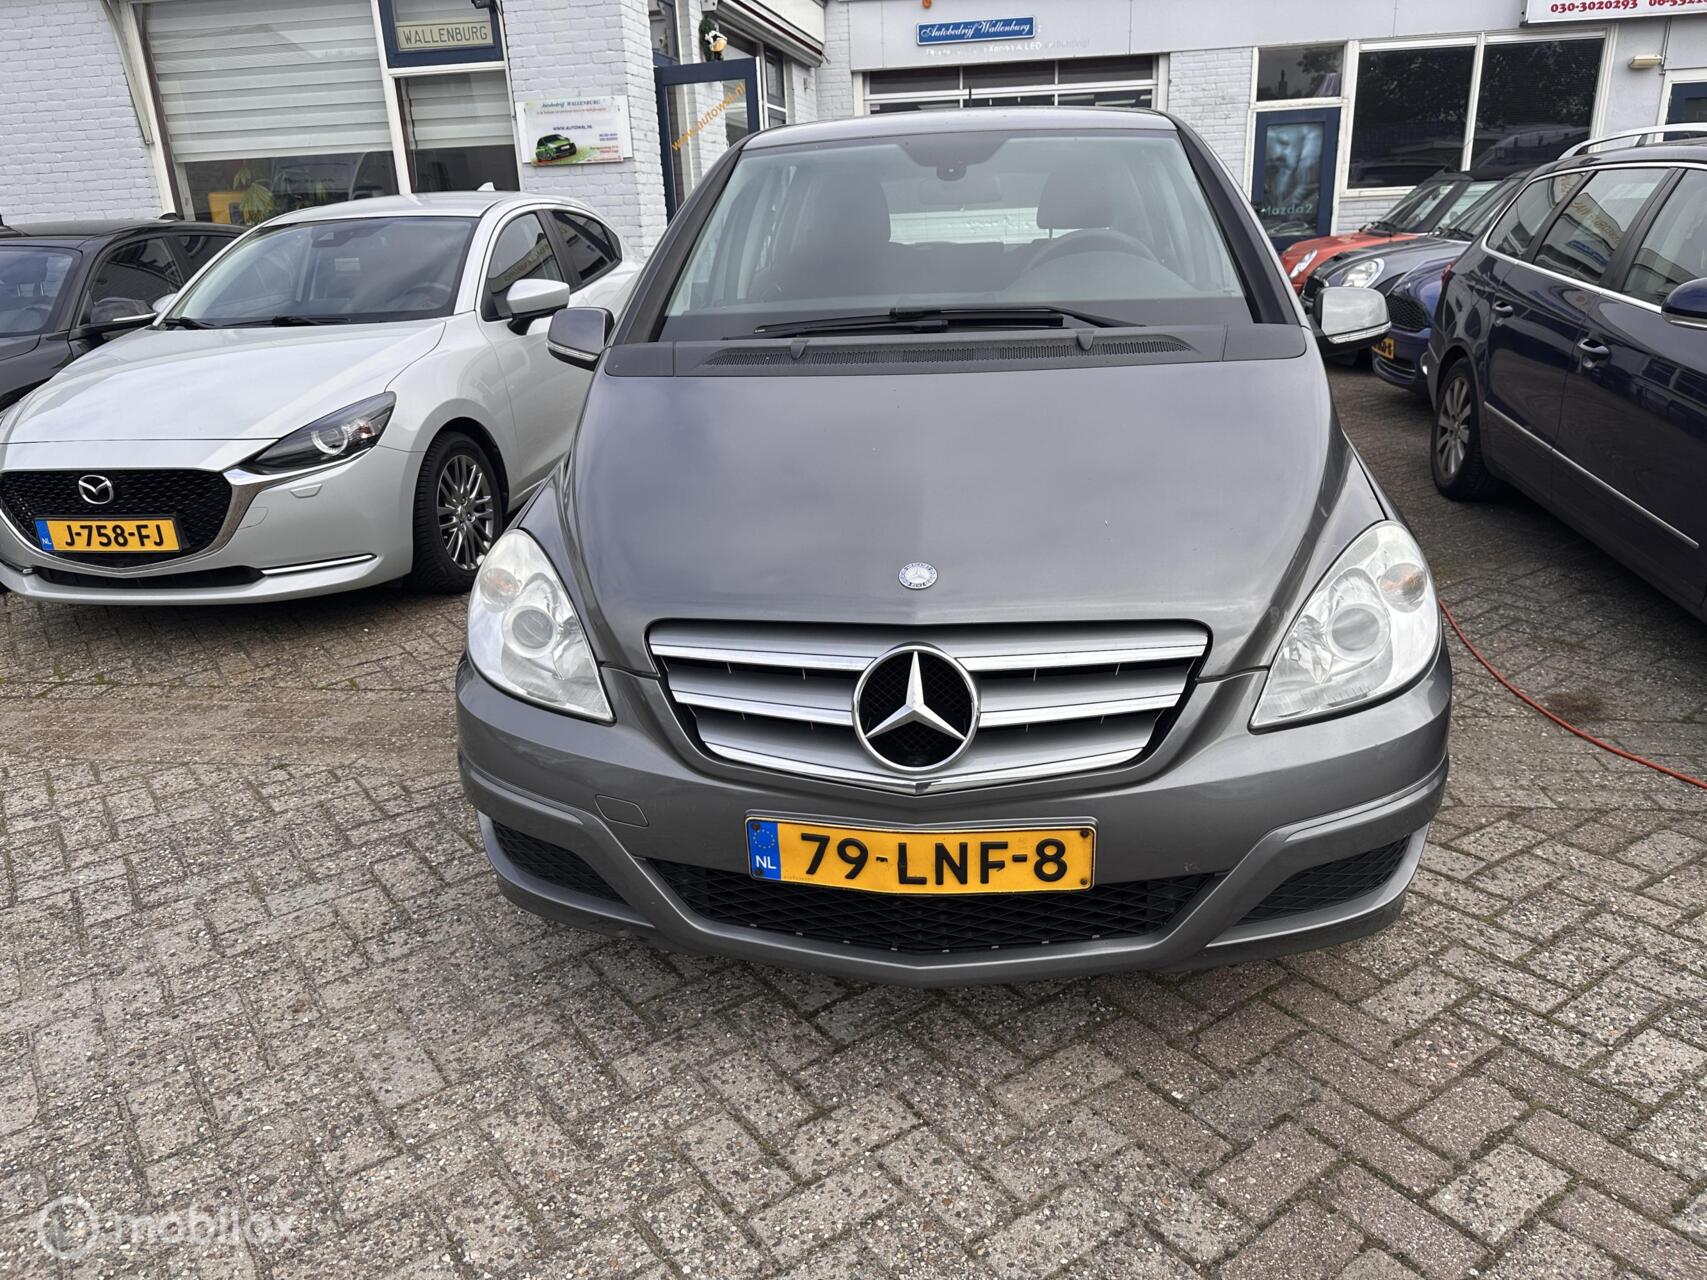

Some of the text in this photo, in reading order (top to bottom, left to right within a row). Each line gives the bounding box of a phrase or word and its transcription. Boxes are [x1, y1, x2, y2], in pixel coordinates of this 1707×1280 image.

[1550, 0, 1638, 13] 030-3020293
[402, 26, 488, 45] WALLENBURG
[920, 20, 1031, 39] Autobedrijf Wallenburg
[41, 538, 52, 546] NL
[64, 524, 165, 547] J-758-FJ
[755, 854, 777, 870] NL
[800, 832, 1068, 886] 79-LNF-8
